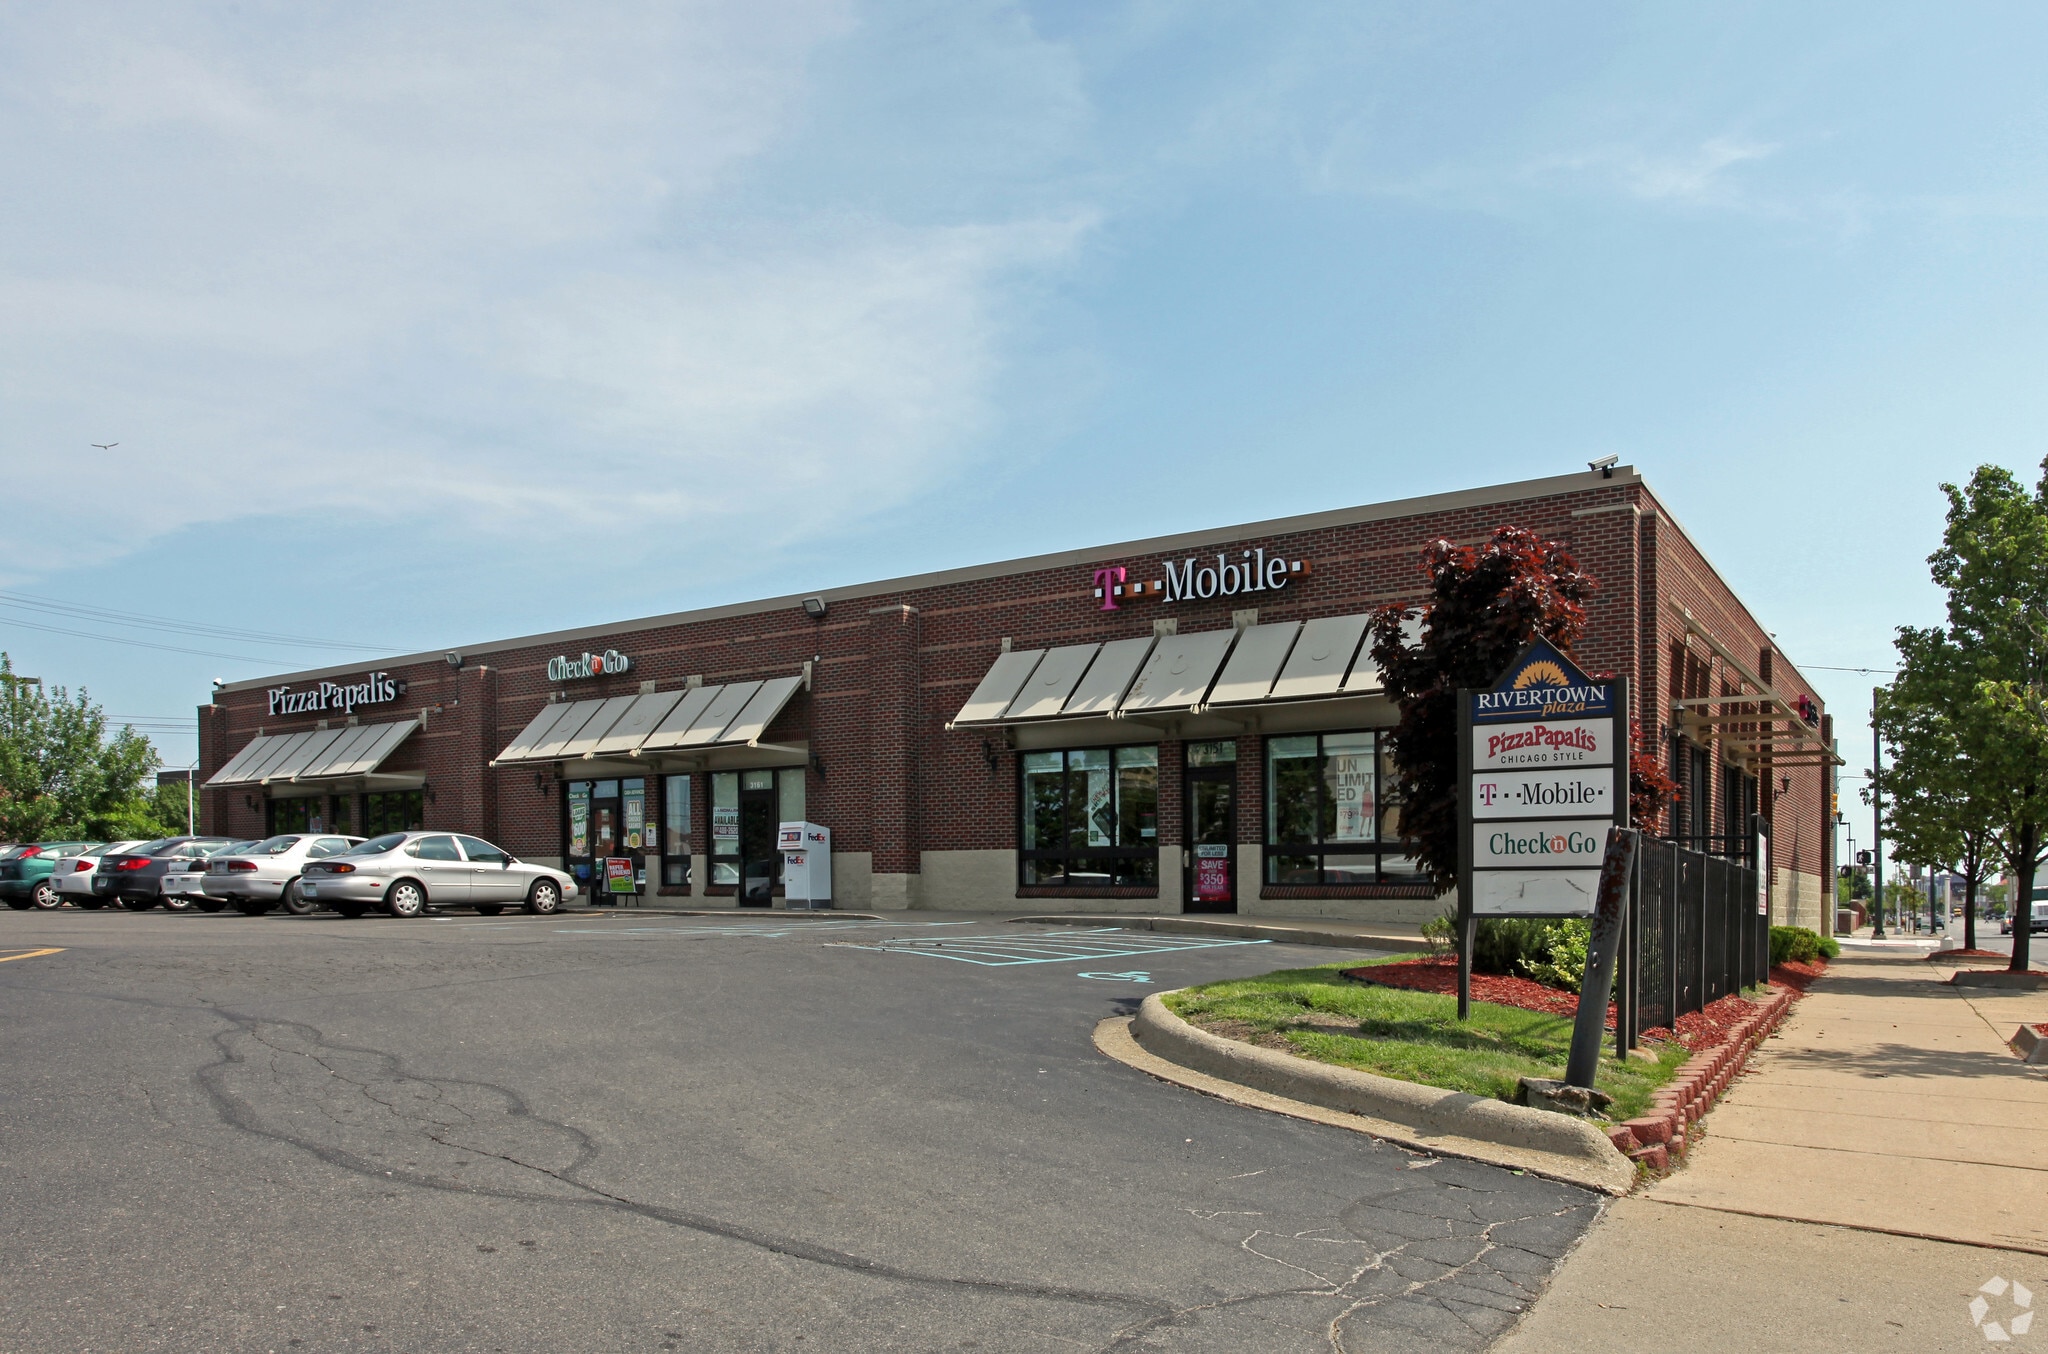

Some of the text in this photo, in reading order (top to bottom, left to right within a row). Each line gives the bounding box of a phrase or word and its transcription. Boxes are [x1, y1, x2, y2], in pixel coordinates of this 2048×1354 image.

[1094, 548, 1288, 611] T Mobile
[548, 652, 590, 681] Check
[603, 649, 626, 674] Go
[1478, 685, 1606, 709] RIVERTOWN
[1541, 700, 1585, 717] plaza
[1488, 725, 1597, 758] PizzaPapalis
[1500, 752, 1584, 764] CHICAGO STYLE
[1337, 759, 1358, 773] UN
[1337, 772, 1374, 787] LIMIT
[1337, 787, 1356, 801] ED
[1479, 781, 1595, 806] T Mobile
[573, 807, 585, 815] LOANS
[628, 803, 641, 815] ALL
[714, 816, 740, 825] AVAILABLE
[808, 832, 826, 842] FedEx
[1489, 832, 1551, 855] Check
[1568, 832, 1596, 853] Go
[787, 856, 804, 864] FedEx
[1201, 860, 1224, 869] SAVE
[1200, 873, 1224, 885] $350
